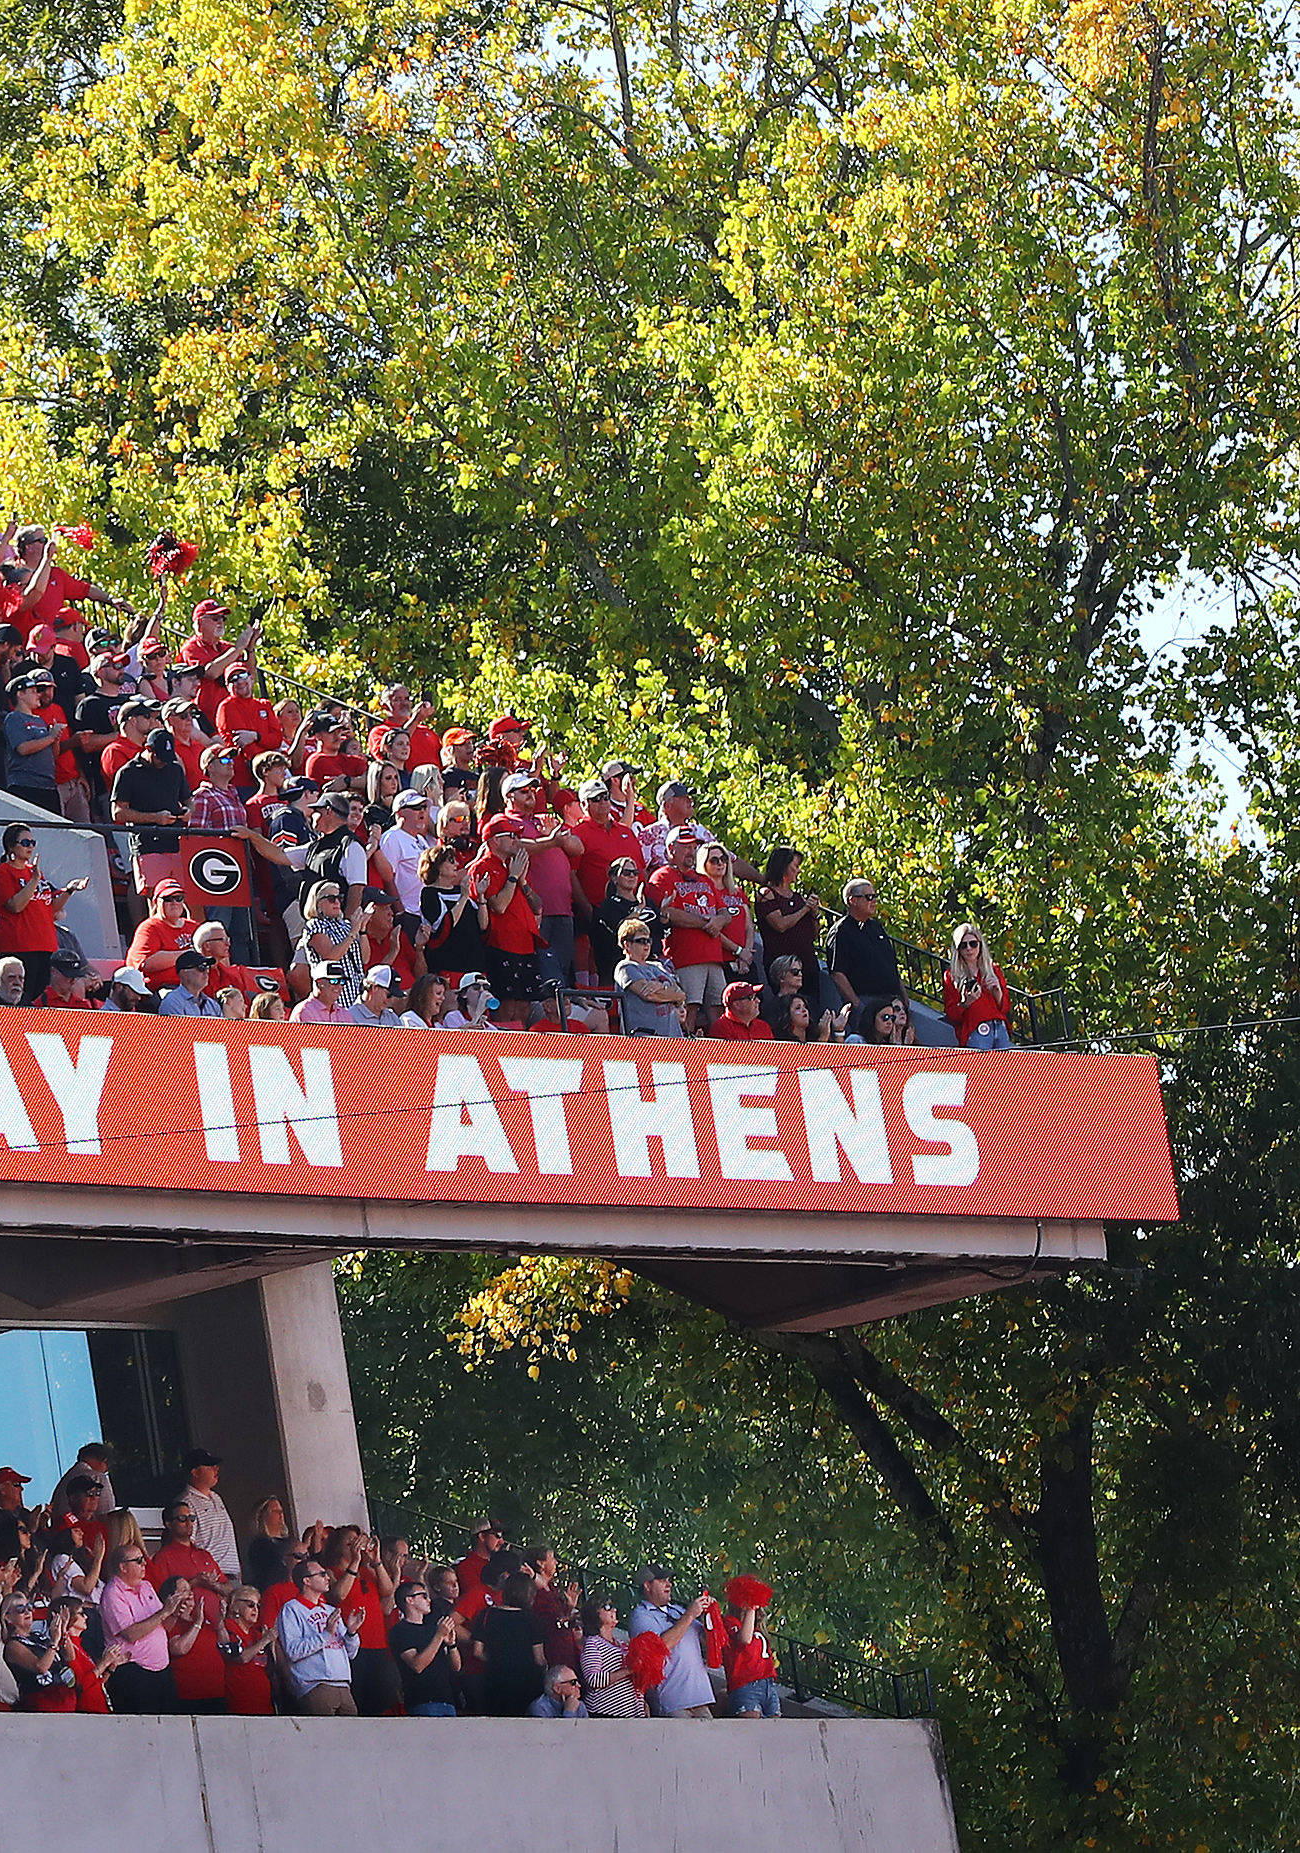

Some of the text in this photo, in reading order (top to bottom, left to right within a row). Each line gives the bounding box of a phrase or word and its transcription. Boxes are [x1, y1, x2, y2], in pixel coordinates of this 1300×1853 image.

[189, 848, 242, 895] G
[192, 1041, 344, 1168] IN
[425, 1054, 981, 1188] ATHENS
